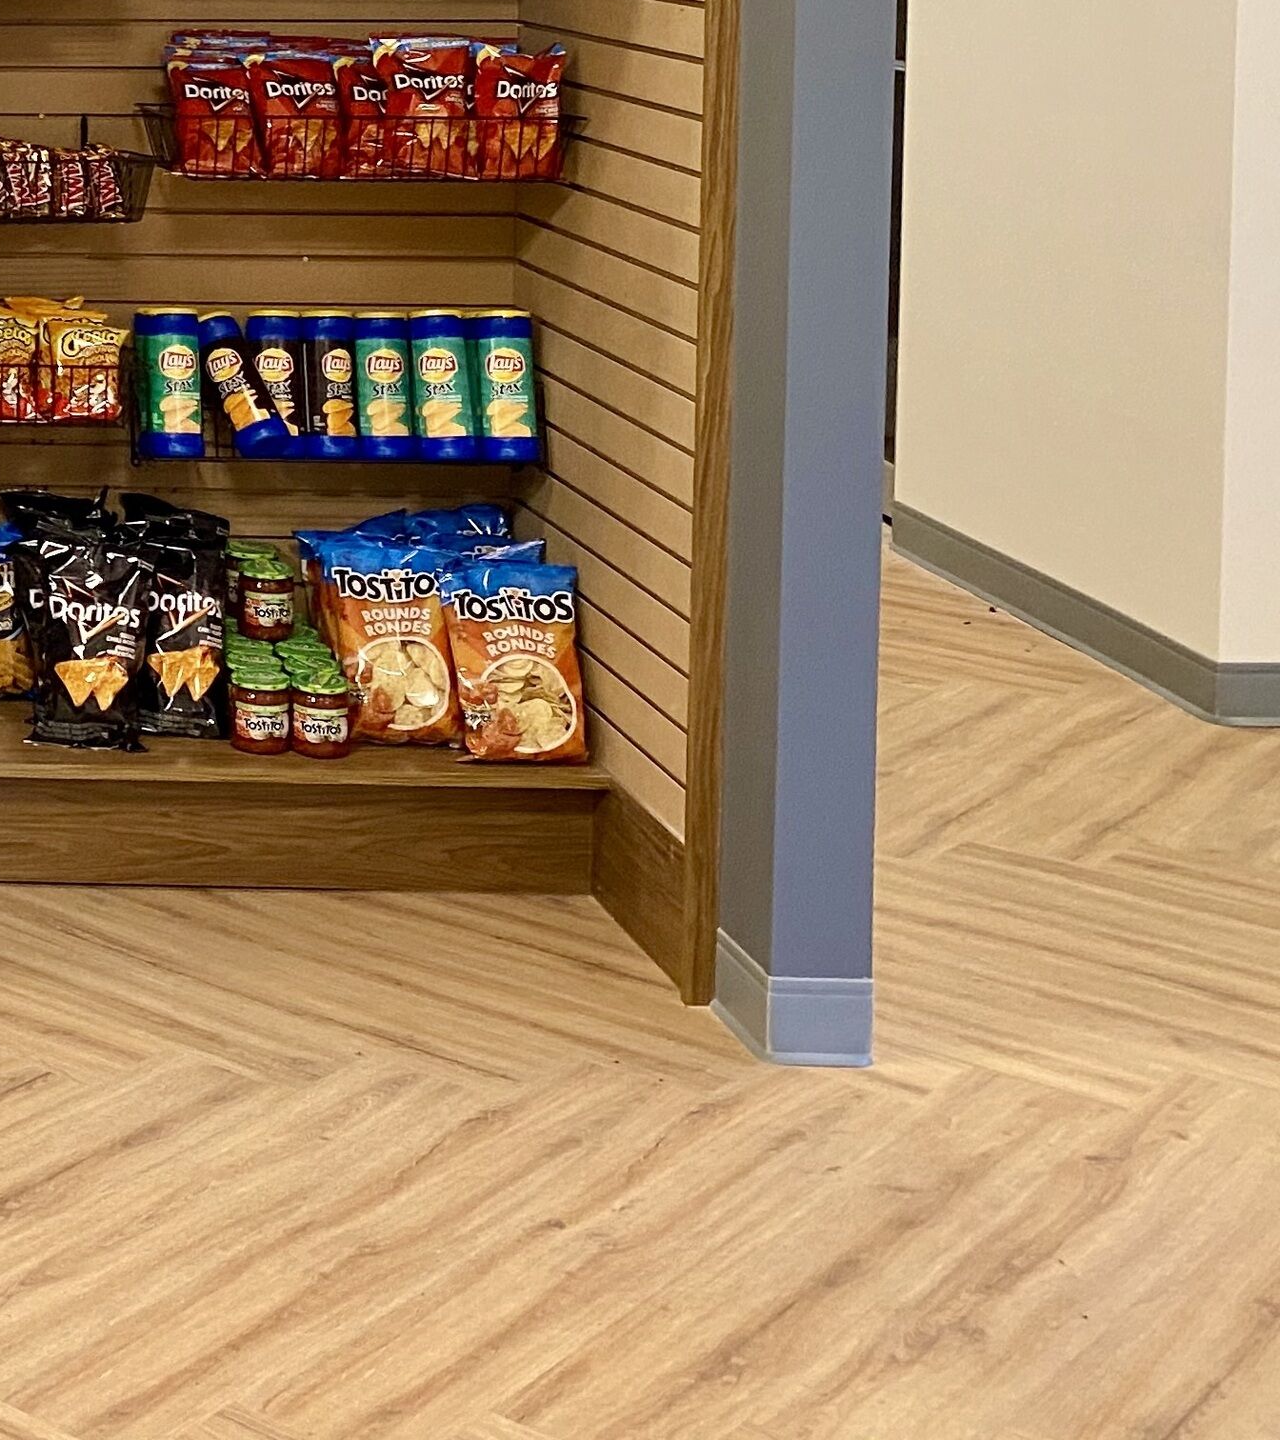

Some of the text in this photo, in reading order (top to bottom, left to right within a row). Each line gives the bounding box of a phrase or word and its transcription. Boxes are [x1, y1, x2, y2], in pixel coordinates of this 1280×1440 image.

[265, 80, 337, 98] Doritos
[393, 72, 465, 90] Doritos
[496, 80, 558, 99] Doritos
[369, 356, 401, 373] Lay's
[422, 356, 453, 372] Lay's
[491, 356, 522, 372] Lay's
[332, 568, 439, 602] TOSTITO
[48, 594, 141, 629] Doritos
[252, 606, 291, 619] TOSTITO
[361, 606, 432, 622] ROUNDS
[363, 620, 433, 637] RONDES
[481, 624, 555, 644] ROUNDS
[485, 638, 557, 659] RONDES
